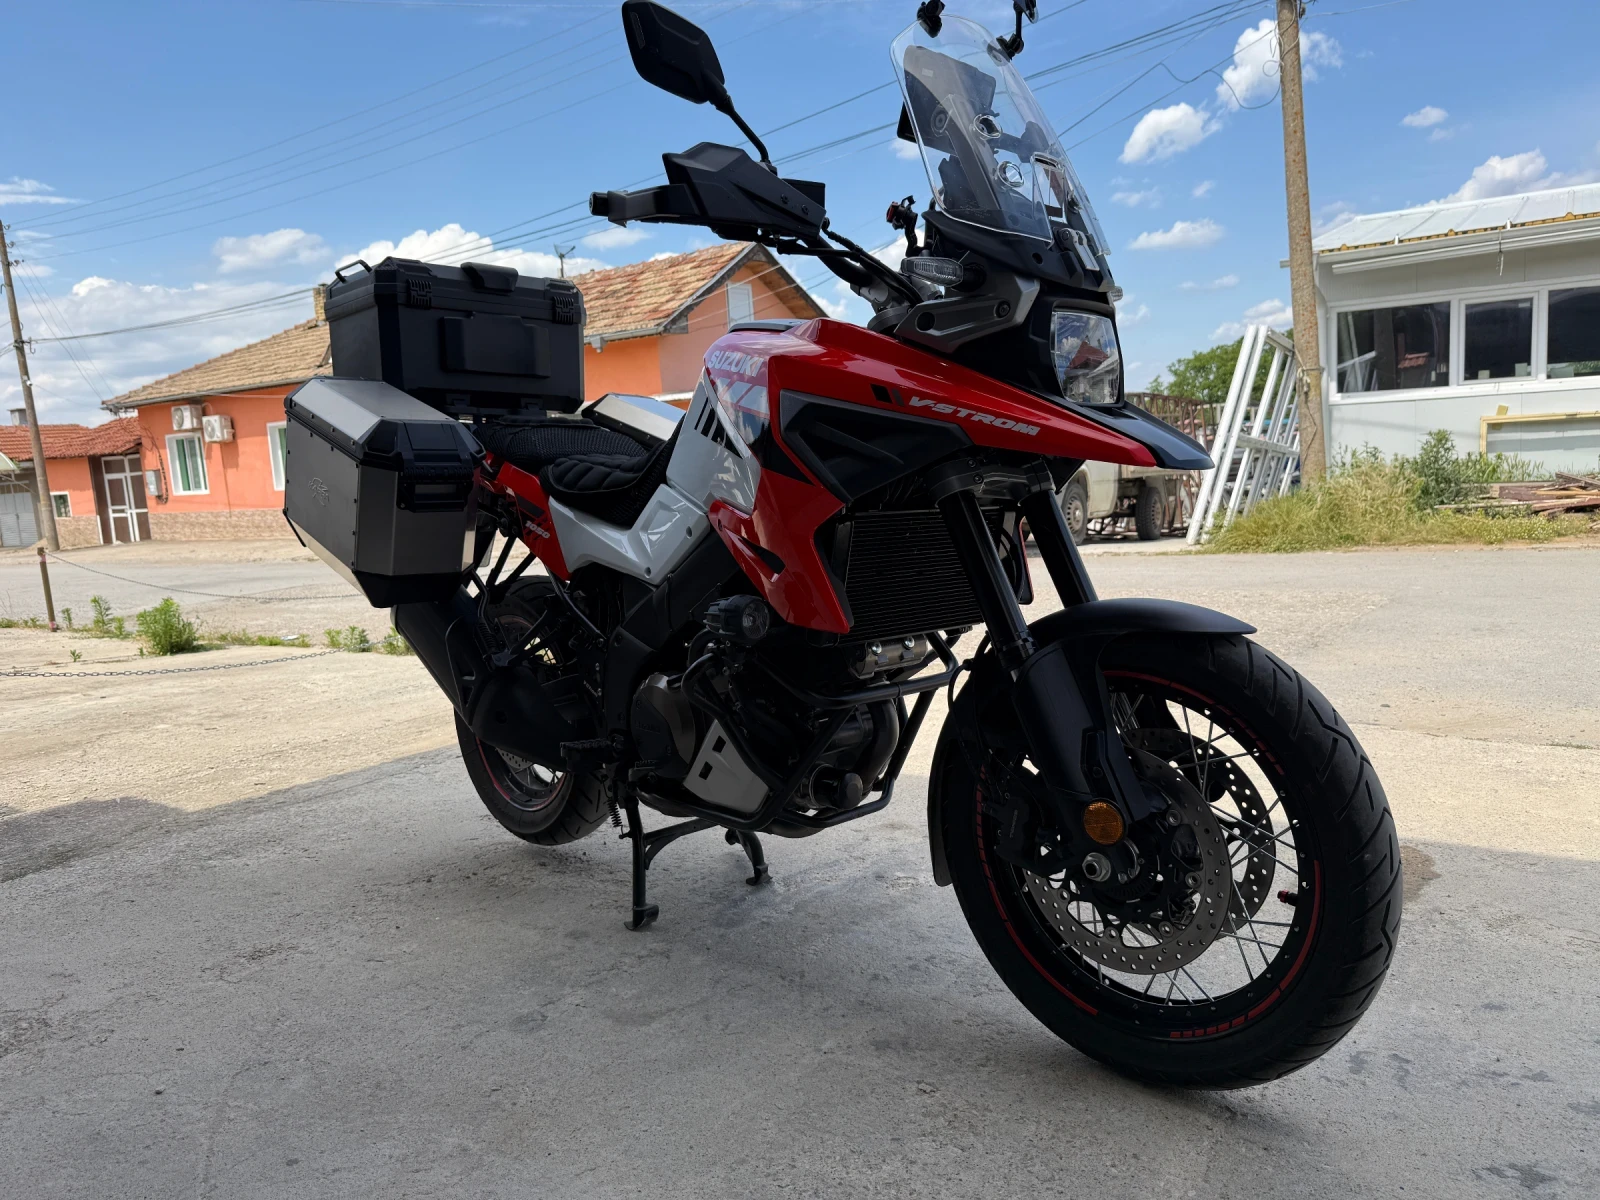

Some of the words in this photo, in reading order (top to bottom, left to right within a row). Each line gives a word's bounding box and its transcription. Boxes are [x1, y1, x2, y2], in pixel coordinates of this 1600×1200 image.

[708, 351, 764, 377] SUZUKI
[909, 396, 1041, 436] V-STROM
[525, 520, 551, 539] 1050
